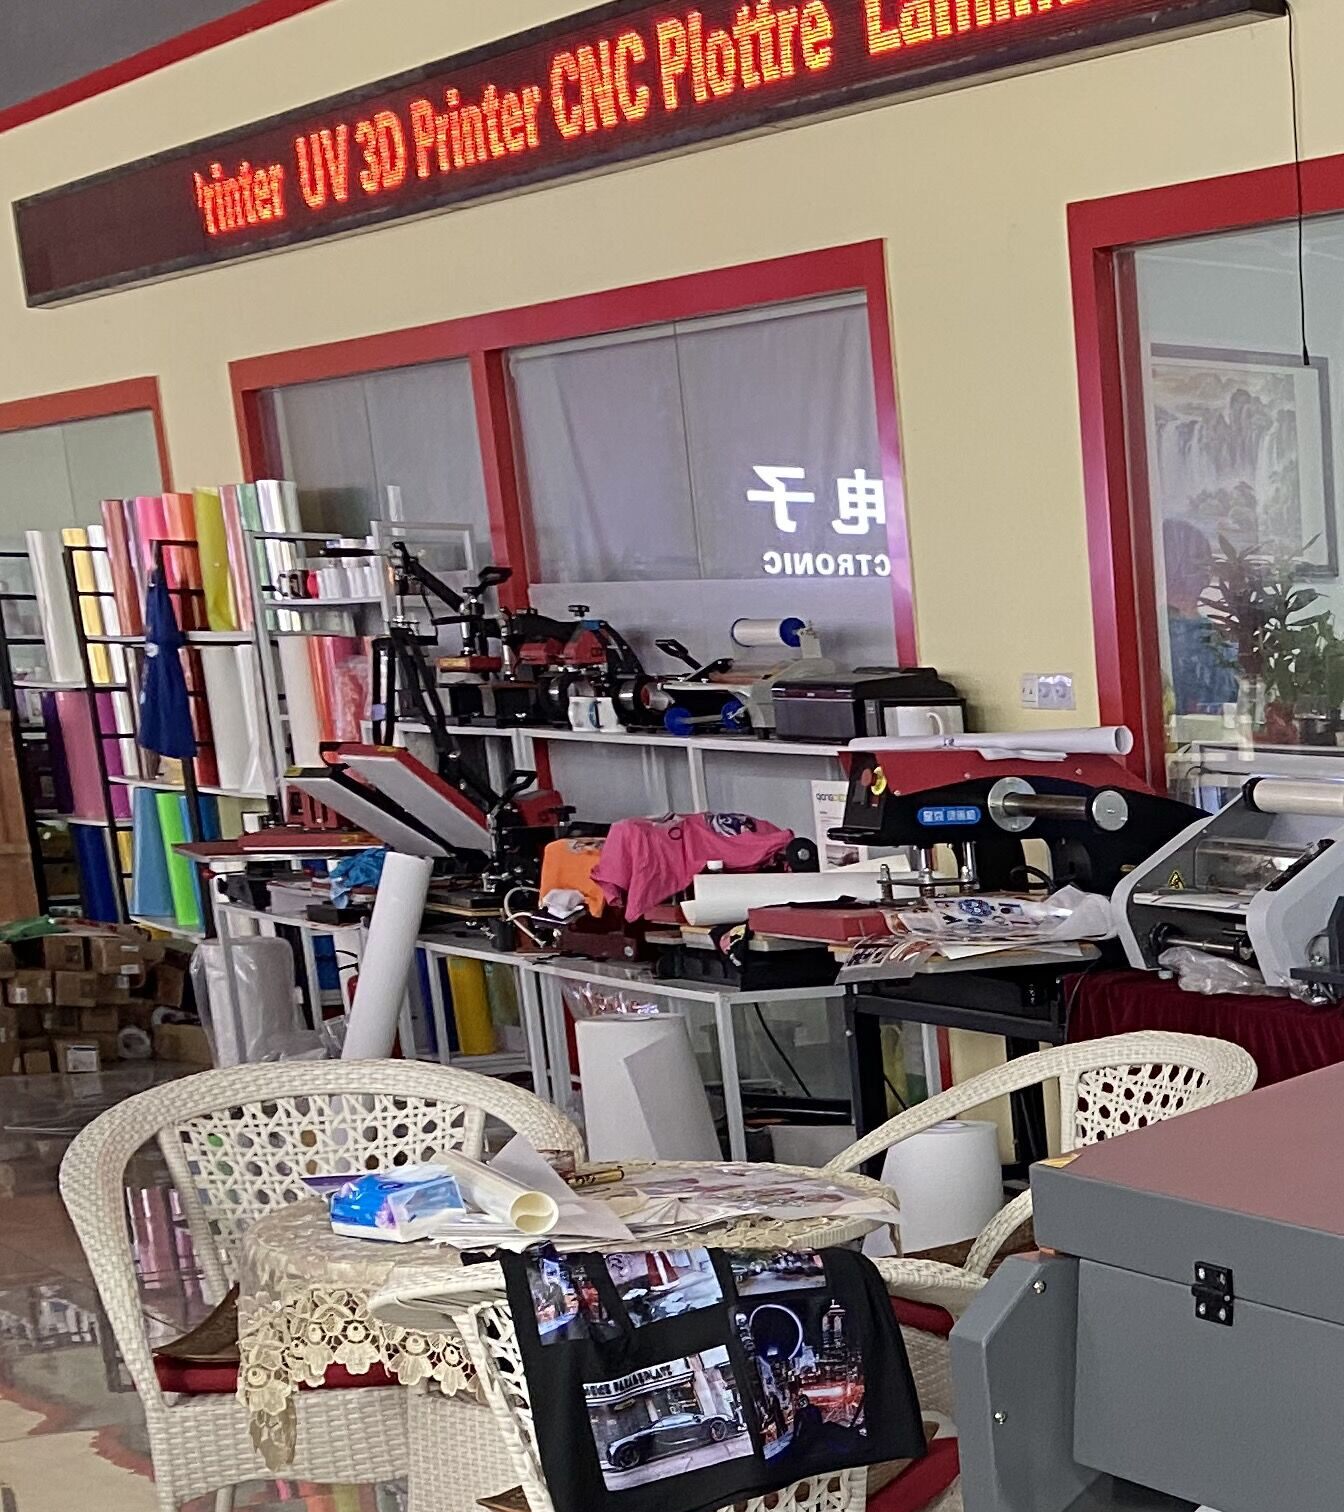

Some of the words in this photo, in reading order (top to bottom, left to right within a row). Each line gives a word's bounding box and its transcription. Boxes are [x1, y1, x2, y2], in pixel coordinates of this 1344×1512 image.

[295, 124, 349, 208] UV
[355, 110, 407, 196] 3D
[410, 82, 542, 178] Printer
[548, 32, 650, 140] CNC
